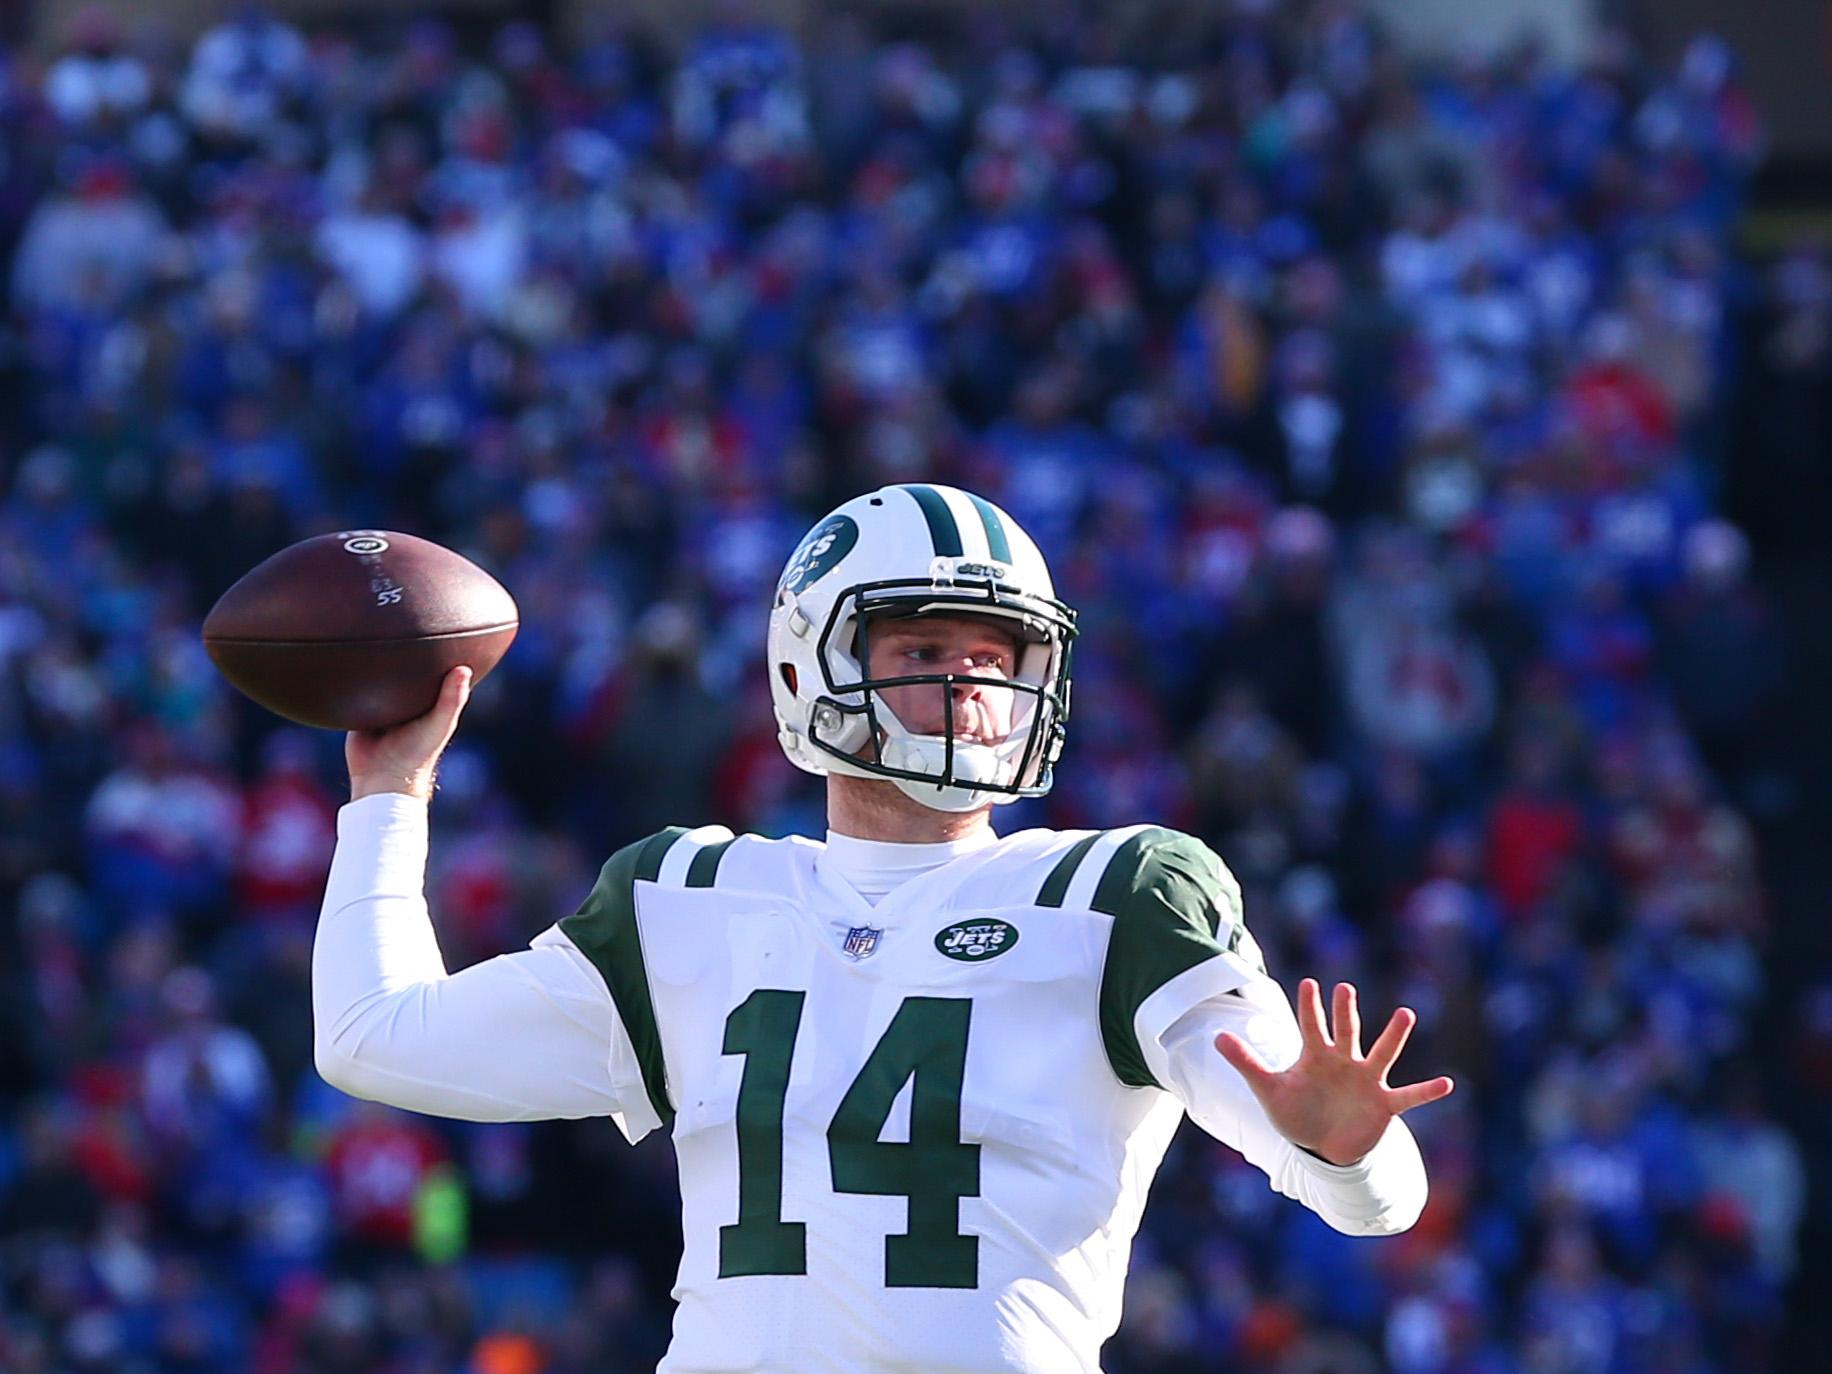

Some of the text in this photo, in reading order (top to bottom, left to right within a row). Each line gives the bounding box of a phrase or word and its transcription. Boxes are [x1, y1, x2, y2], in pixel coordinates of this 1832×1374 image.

[957, 563, 1005, 578] JETS
[847, 937, 875, 953] NFL
[944, 931, 1006, 948] JETS
[718, 989, 982, 1290] 14
